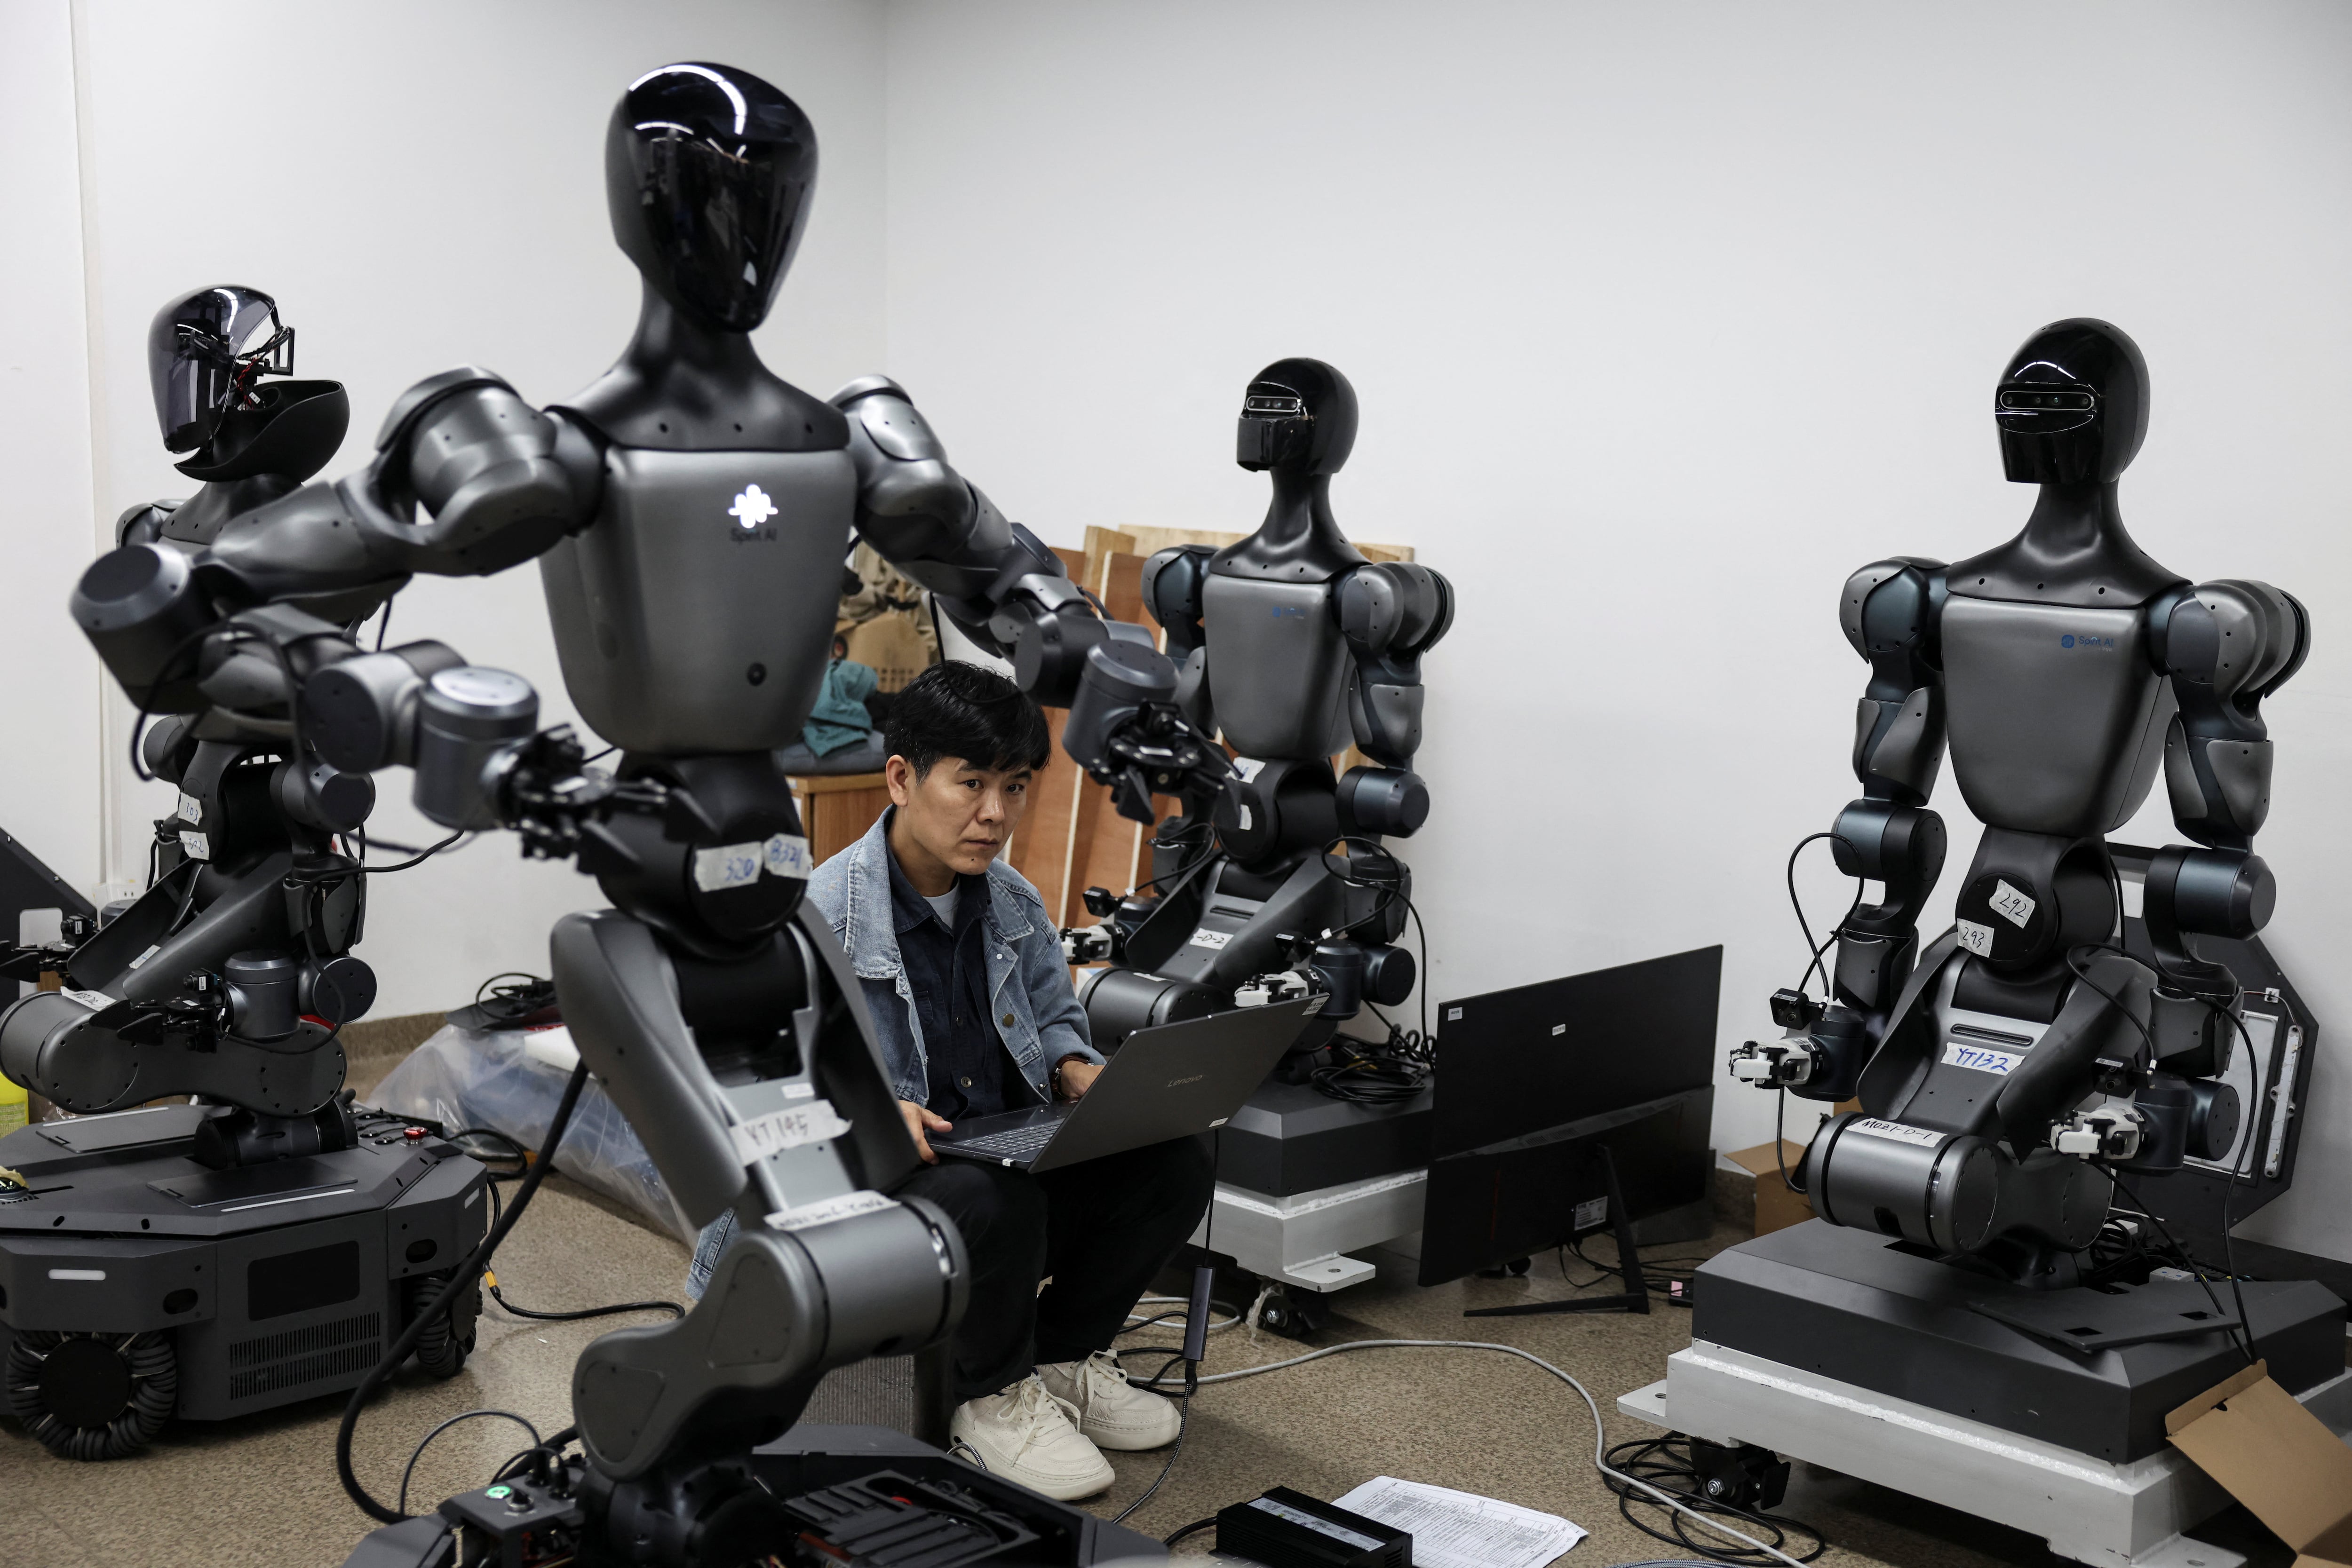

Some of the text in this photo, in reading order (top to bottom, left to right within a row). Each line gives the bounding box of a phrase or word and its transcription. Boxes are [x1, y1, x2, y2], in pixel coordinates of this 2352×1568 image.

[2078, 635, 2114, 647] Spirit AI
[186, 802, 199, 822] 303
[725, 856, 755, 881] 320
[1999, 893, 2026, 918] 292
[1963, 927, 1985, 948] 293
[1958, 1048, 2009, 1072] YT132
[1167, 1075, 1203, 1087] Lenovo
